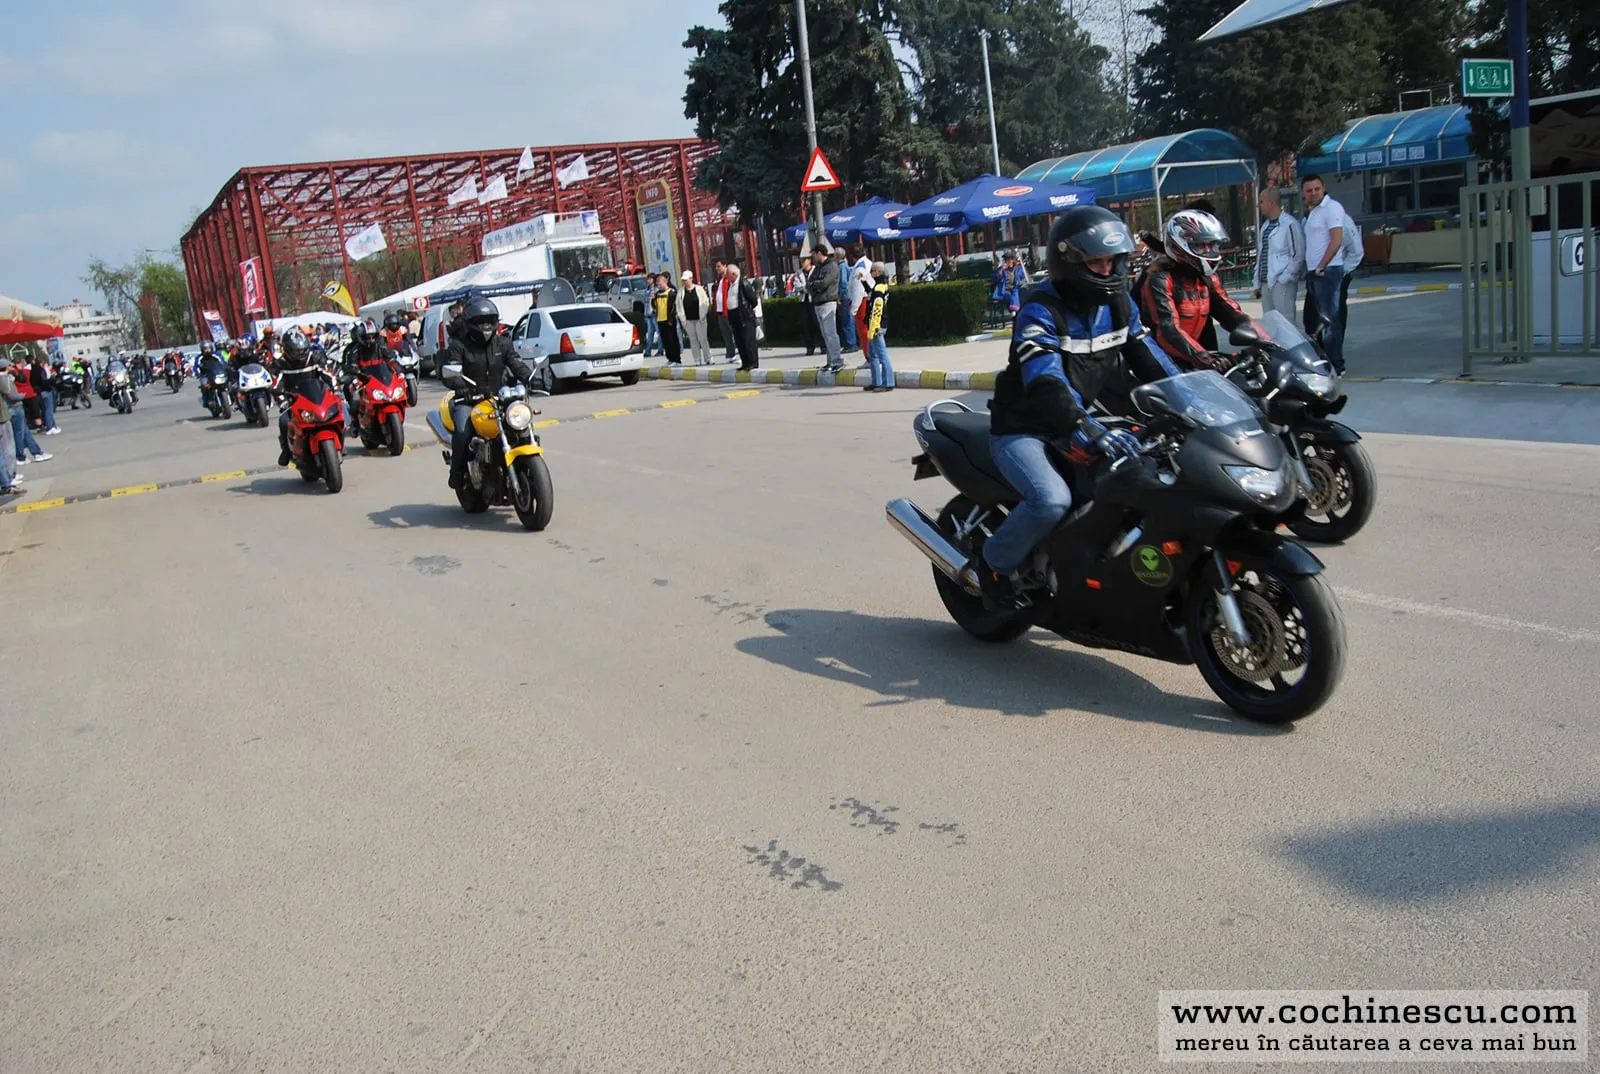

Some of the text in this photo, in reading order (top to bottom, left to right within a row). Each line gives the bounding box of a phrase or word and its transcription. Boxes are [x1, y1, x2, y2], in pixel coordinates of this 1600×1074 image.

[645, 187, 659, 199] INFO
[1049, 194, 1079, 206] BORSEC
[982, 204, 1013, 217] BORSEC
